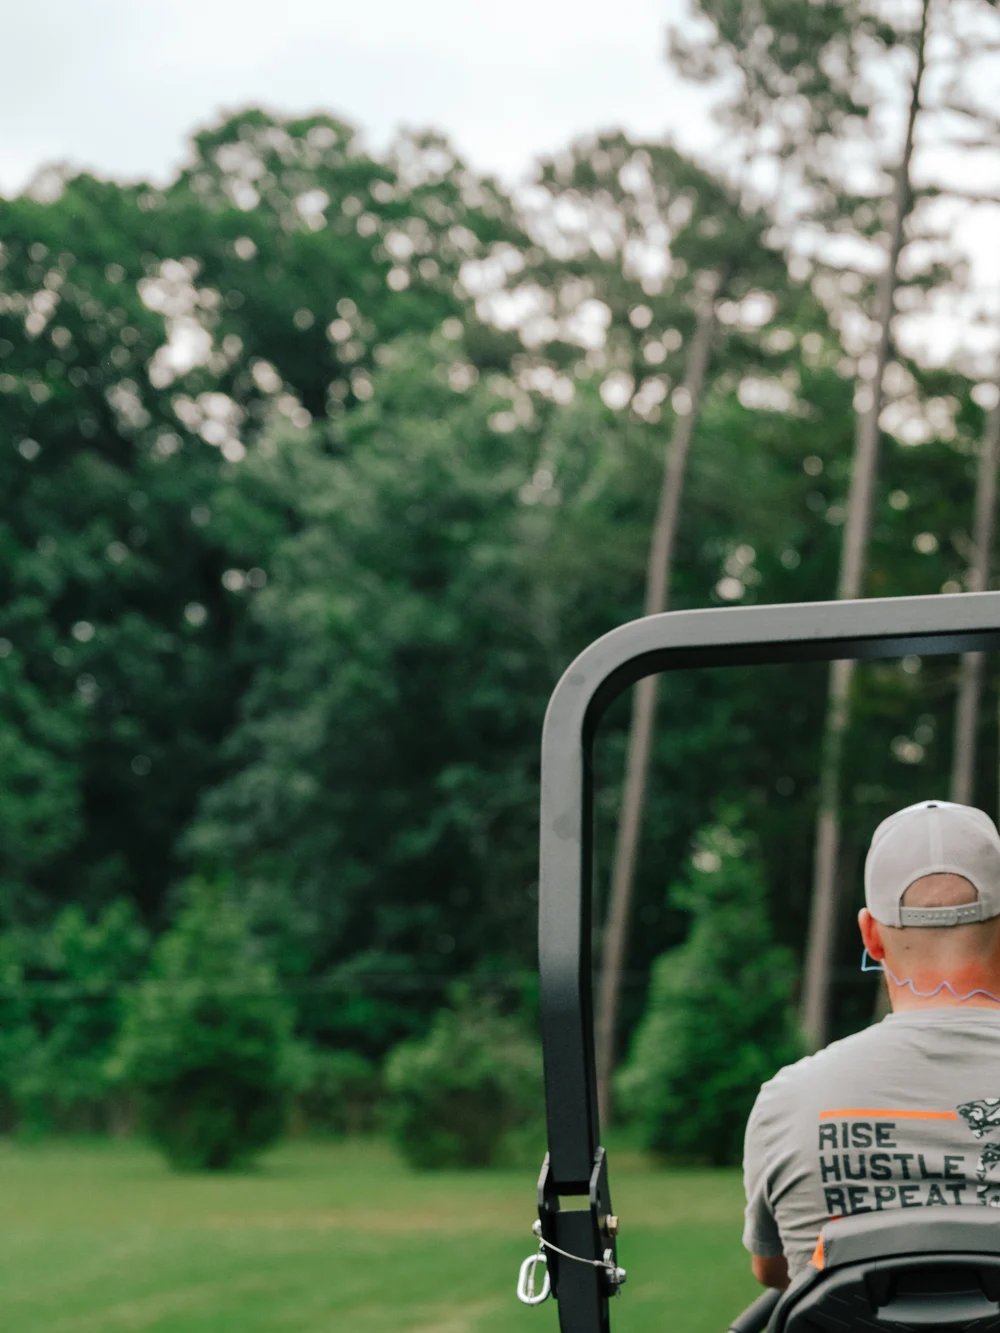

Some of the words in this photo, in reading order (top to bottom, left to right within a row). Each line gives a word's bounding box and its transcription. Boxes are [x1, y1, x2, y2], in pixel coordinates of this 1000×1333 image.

[819, 1122, 897, 1149] RISE
[820, 1154, 966, 1182] HUSTLE
[824, 1184, 967, 1215] REPEAT
